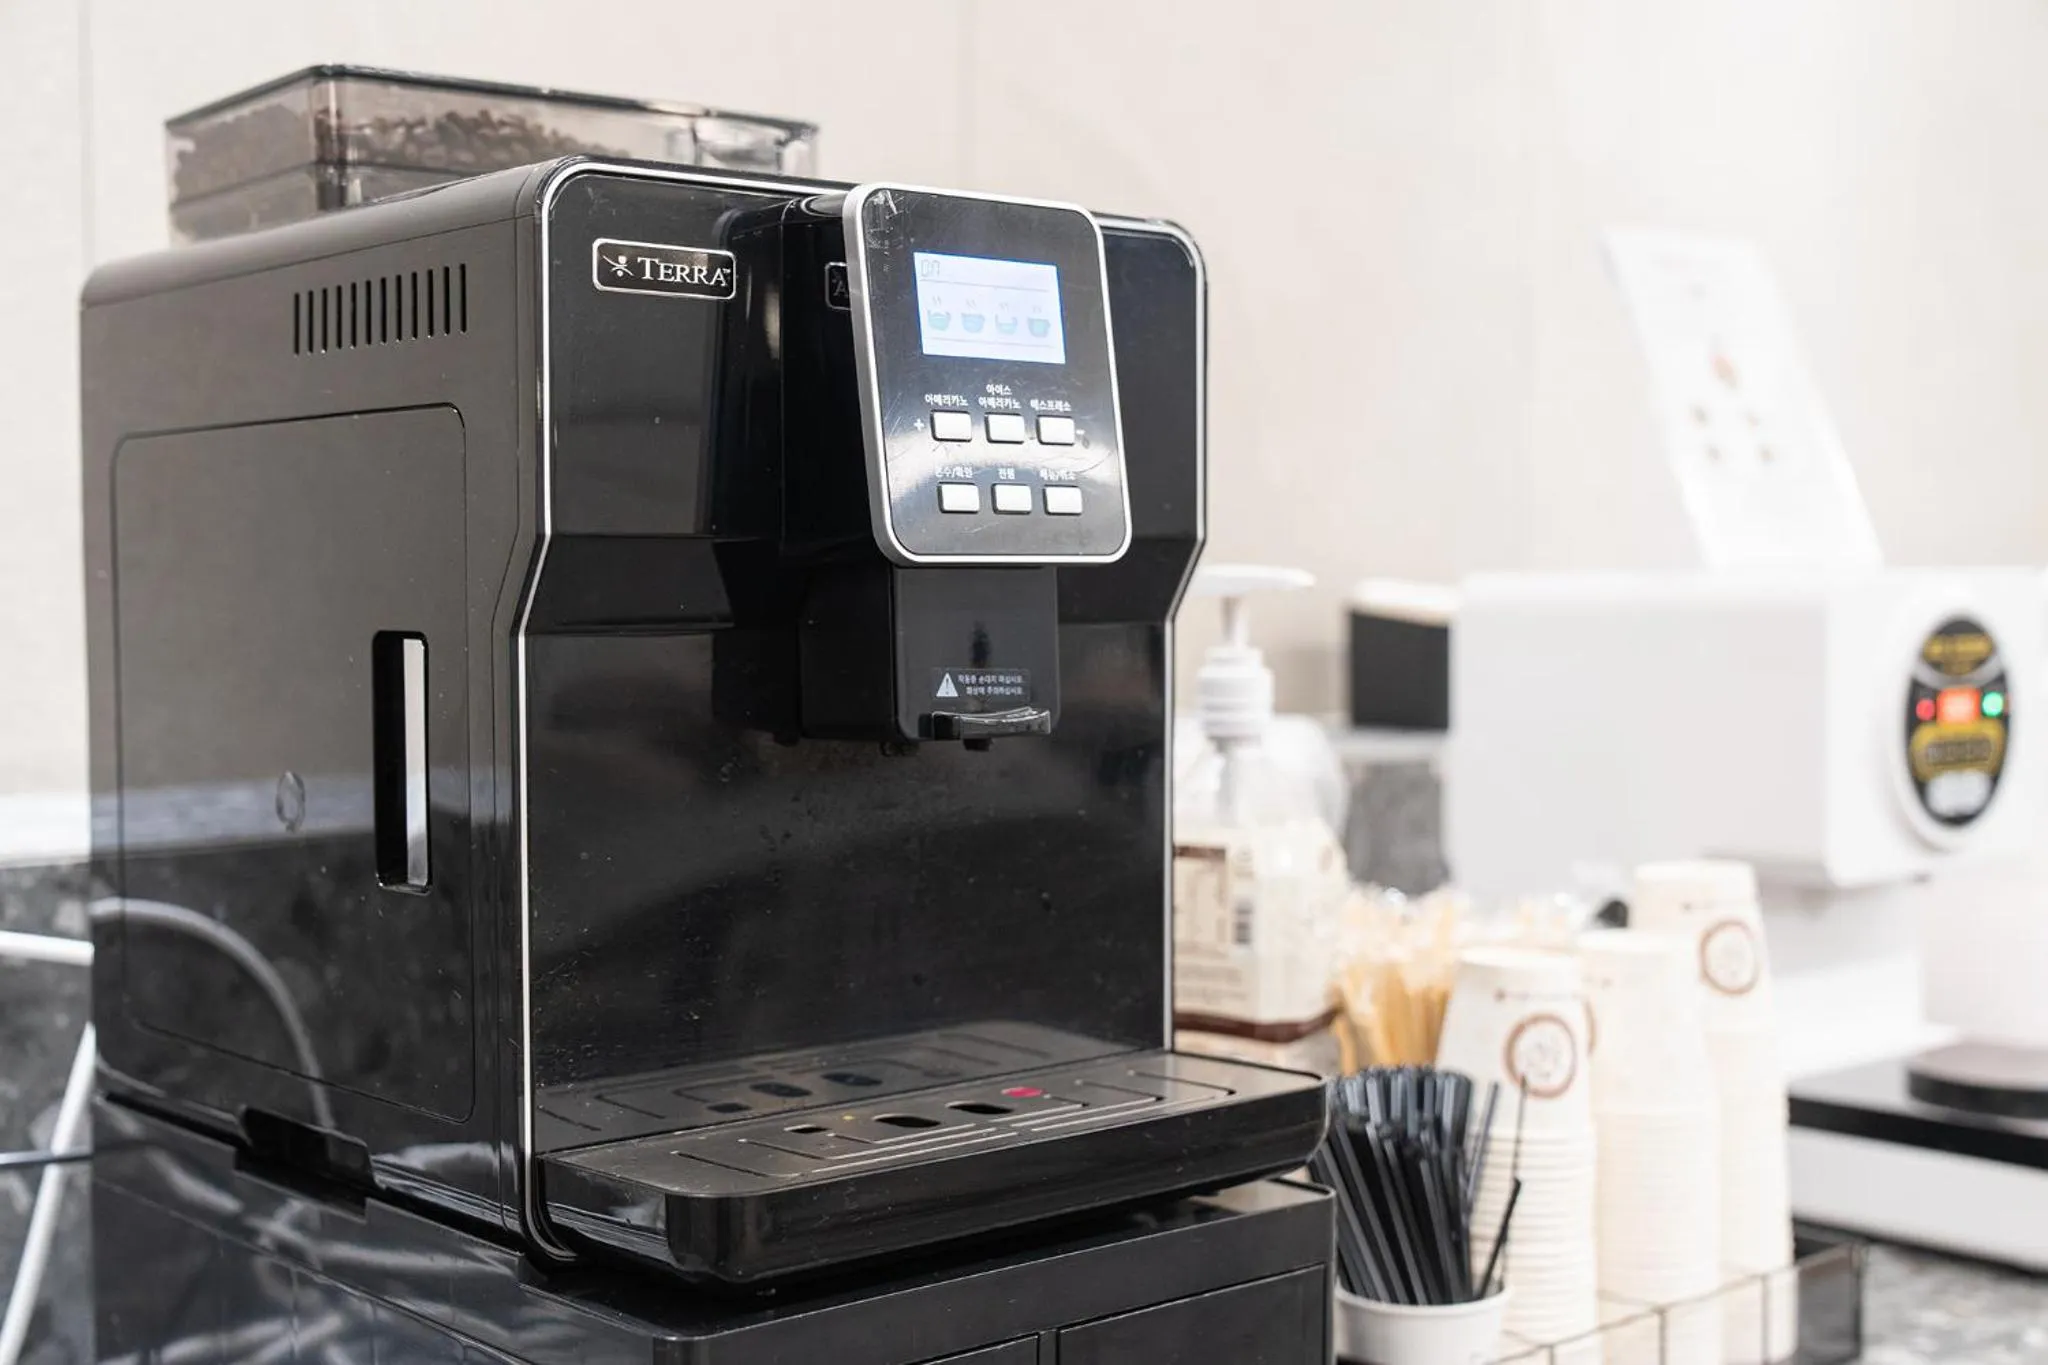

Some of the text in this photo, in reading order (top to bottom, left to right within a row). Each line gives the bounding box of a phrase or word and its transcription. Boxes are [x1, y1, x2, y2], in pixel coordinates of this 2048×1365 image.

[986, 384, 1012, 396] 아이스
[925, 393, 969, 407] 아메리카노
[978, 396, 1022, 410] 아메리카노
[1030, 399, 1072, 412] 에스프레소
